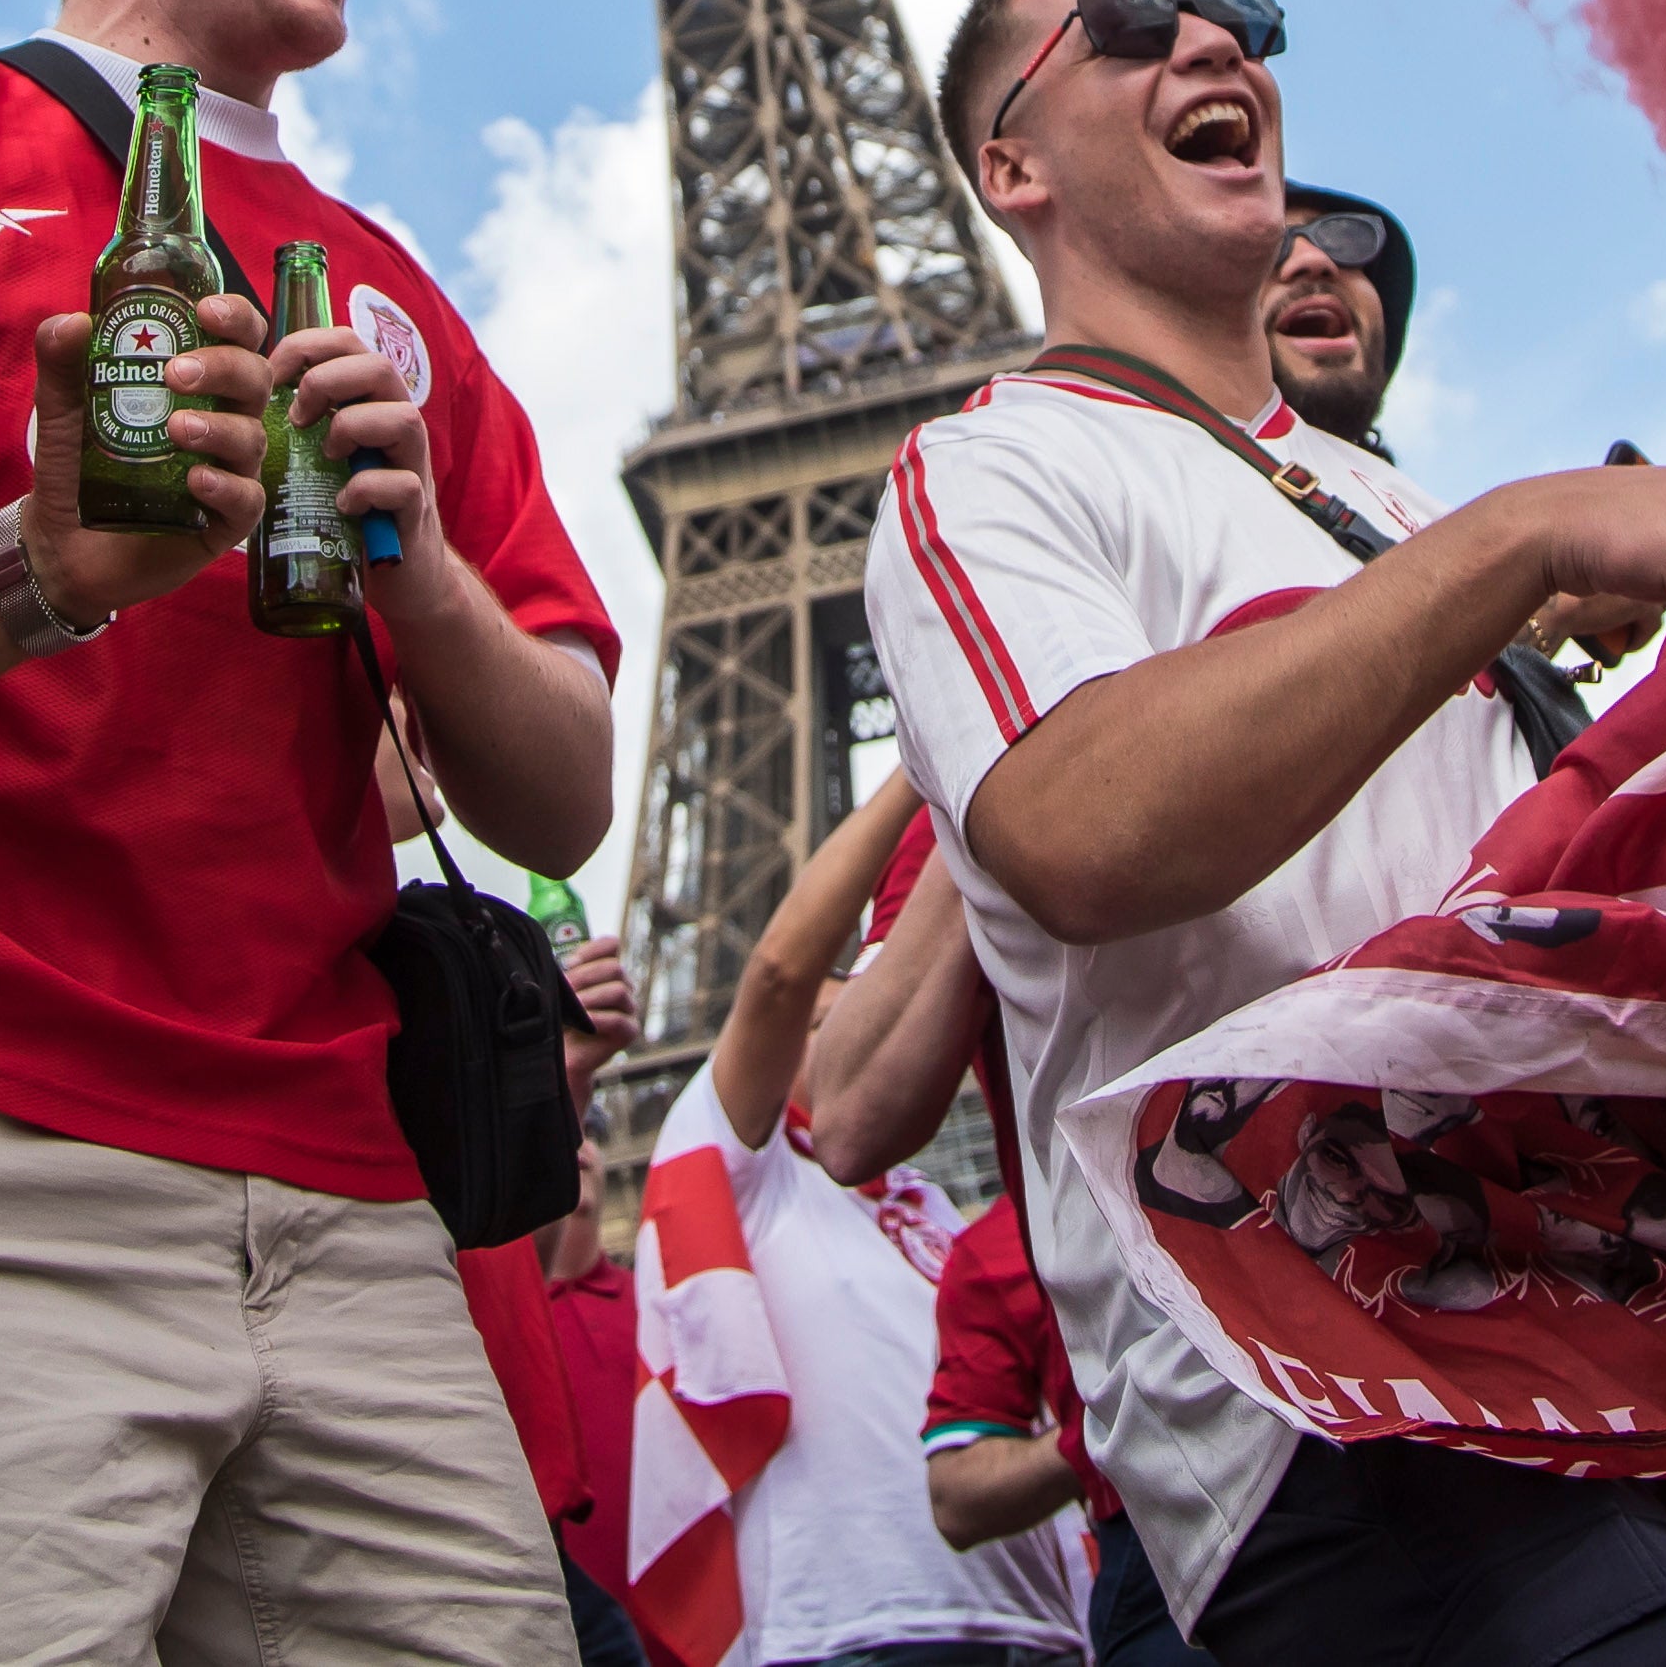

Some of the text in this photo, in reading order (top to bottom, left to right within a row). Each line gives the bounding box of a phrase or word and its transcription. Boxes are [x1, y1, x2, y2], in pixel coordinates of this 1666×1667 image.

[144, 139, 163, 215] Heineken
[101, 303, 145, 347] HEINEKEN
[149, 303, 192, 348] ORIGINAL
[94, 360, 166, 384] Heinek
[99, 410, 121, 438] PURE
[122, 429, 154, 444] MALT
